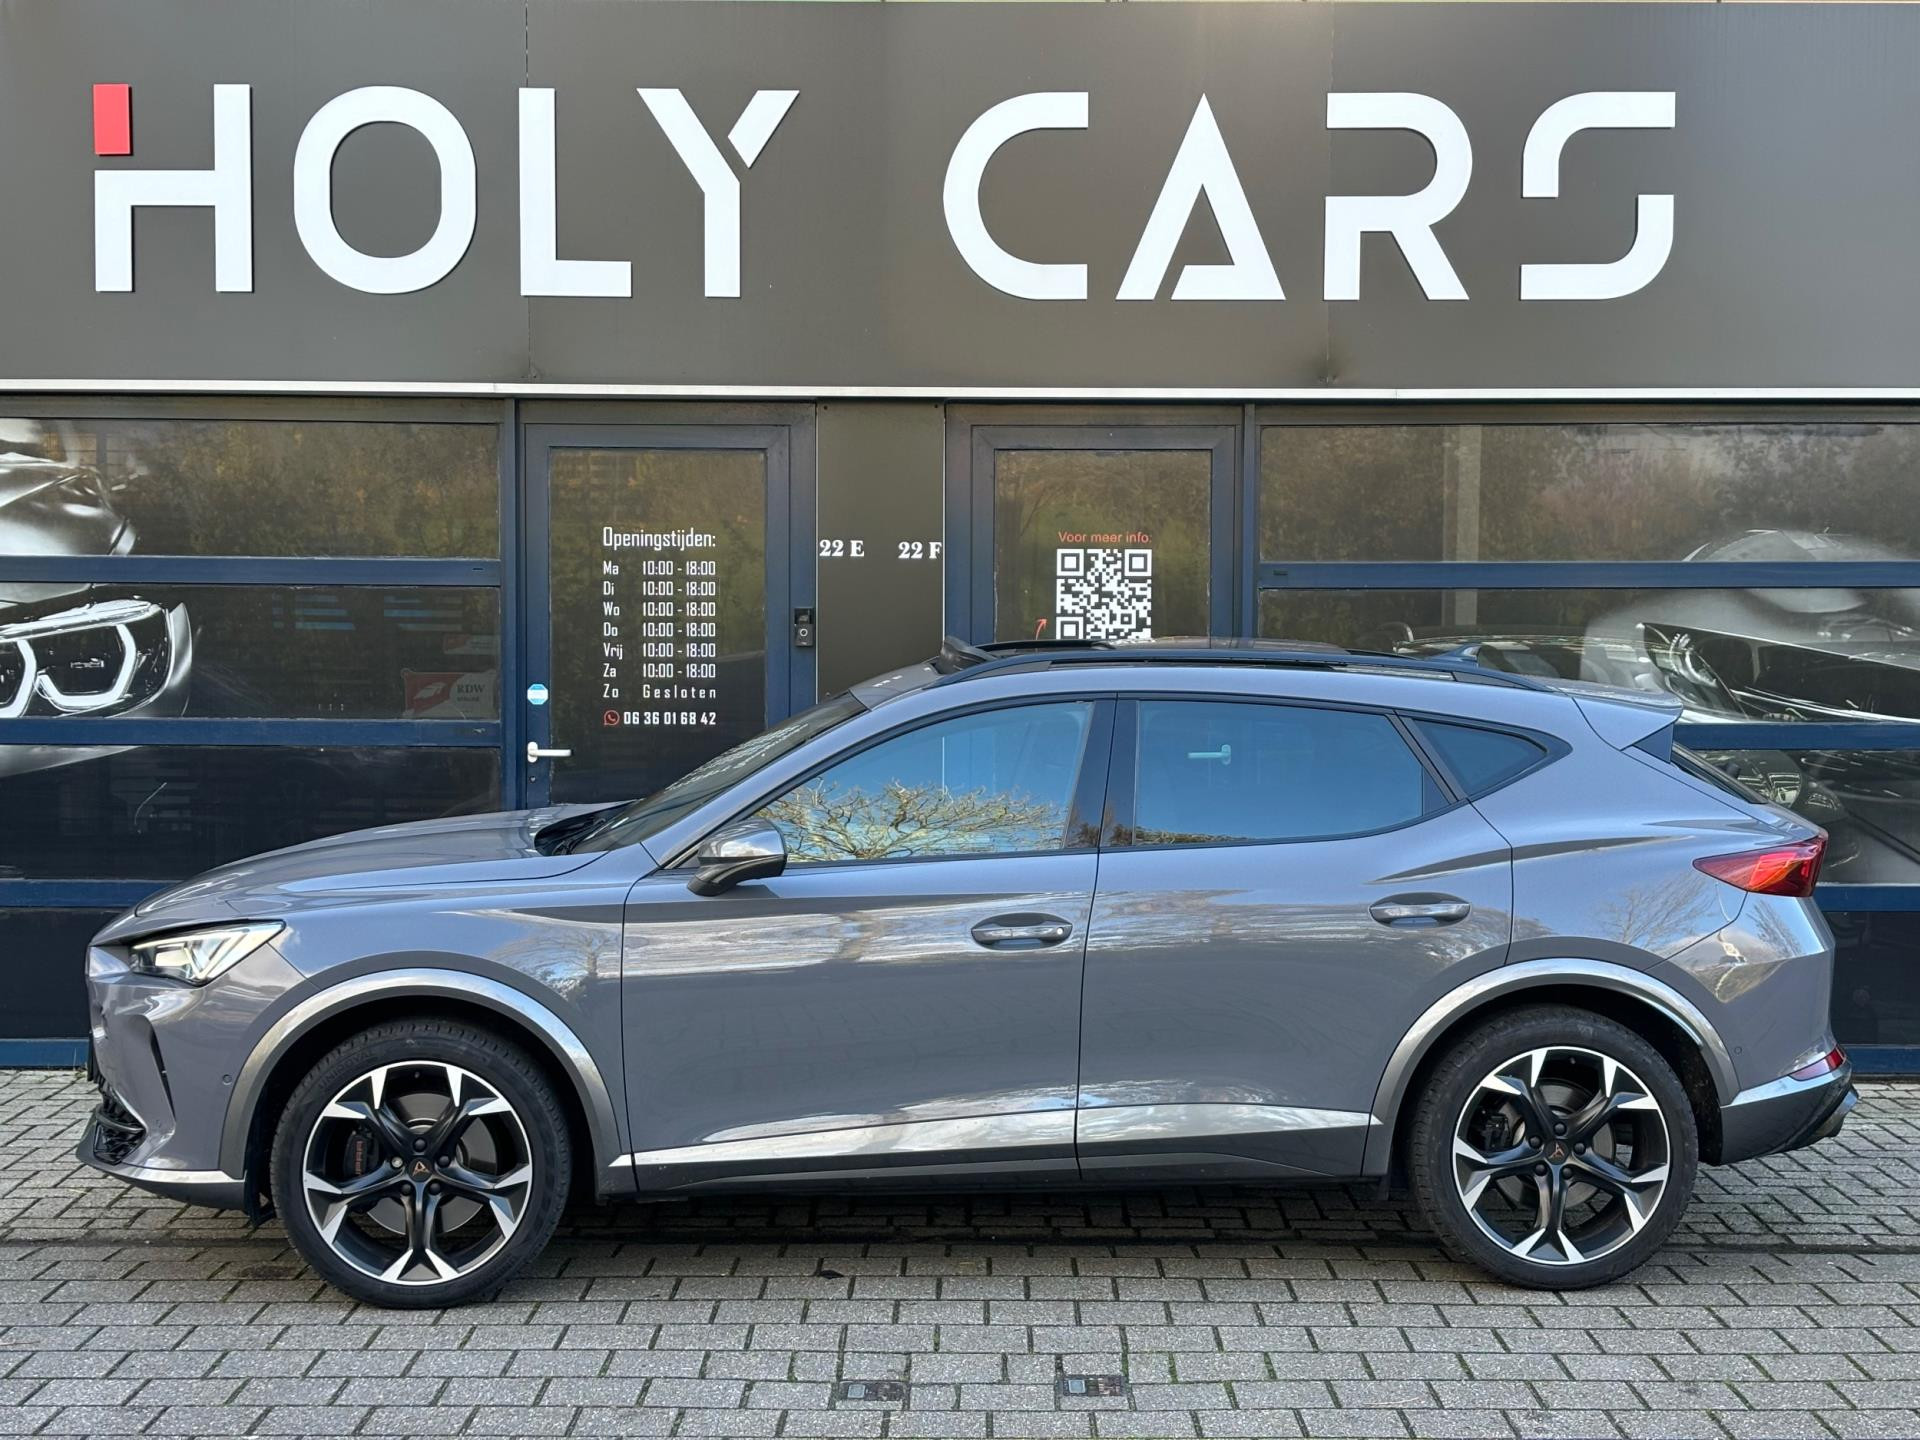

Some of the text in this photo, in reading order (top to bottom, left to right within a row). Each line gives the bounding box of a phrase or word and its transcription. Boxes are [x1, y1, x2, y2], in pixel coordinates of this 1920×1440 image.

[93, 83, 1677, 301] HOLY CARS
[604, 527, 715, 551] Openingstijden:
[1058, 531, 1087, 543] Voor
[1091, 533, 1122, 543] meer
[820, 540, 864, 556] 22 E
[899, 542, 942, 559] 22 F
[604, 561, 618, 574] Ma
[643, 561, 673, 575] 10:00
[687, 561, 715, 575] 18:00
[604, 581, 614, 595] Di
[643, 581, 673, 595] 10:00
[687, 582, 715, 595] 18:00
[603, 602, 619, 615] Wo
[643, 602, 673, 616] 10:00
[687, 602, 715, 616] 18:00
[604, 622, 617, 636] Do
[643, 623, 673, 636] 10:00
[687, 623, 715, 636] 18:00
[604, 643, 622, 659] Vrij
[643, 643, 673, 657] 10:00
[687, 643, 715, 657] 18:00
[604, 663, 616, 677] Za
[643, 664, 673, 677] 10:00
[687, 664, 715, 677] 18:00
[603, 684, 715, 698] Zo Gesloten
[624, 712, 716, 725] 06 36 01 68 42
